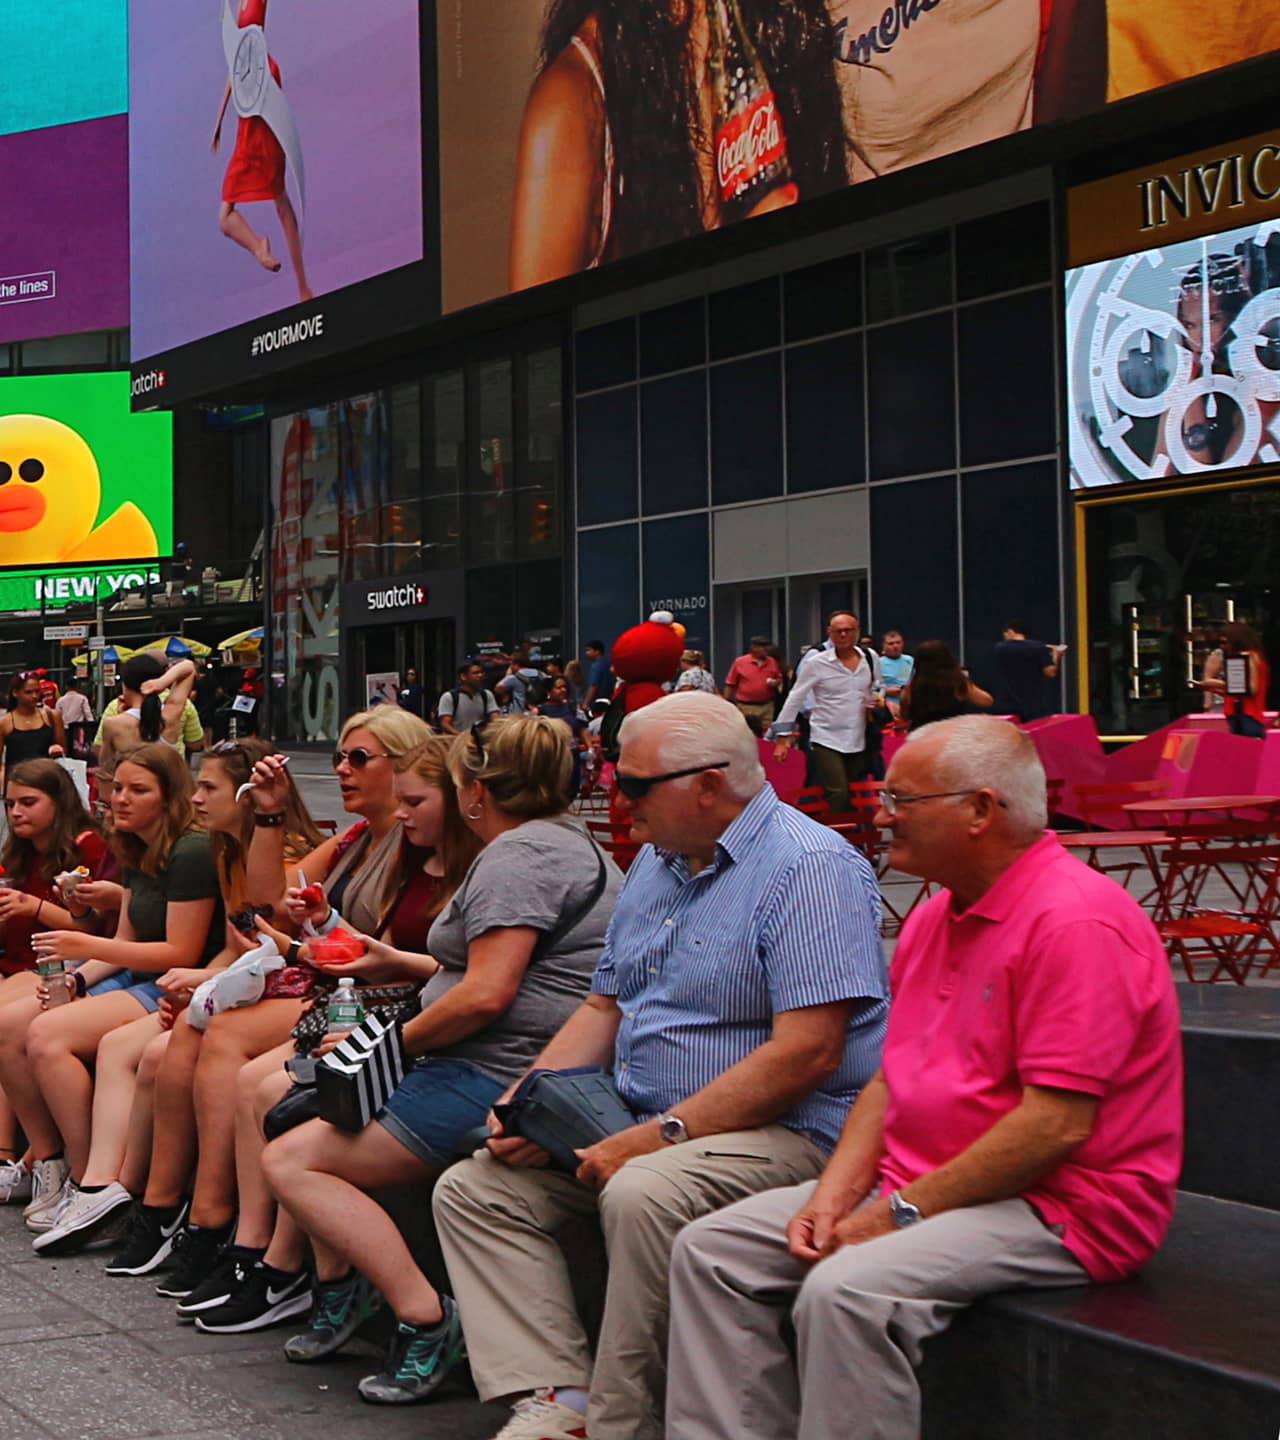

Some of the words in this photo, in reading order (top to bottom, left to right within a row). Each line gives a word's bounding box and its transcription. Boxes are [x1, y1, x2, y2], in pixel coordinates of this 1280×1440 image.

[18, 276, 49, 297] lines
[251, 313, 324, 356] #YOURMOVE
[34, 578, 97, 600] NEW
[366, 583, 419, 610] swatch
